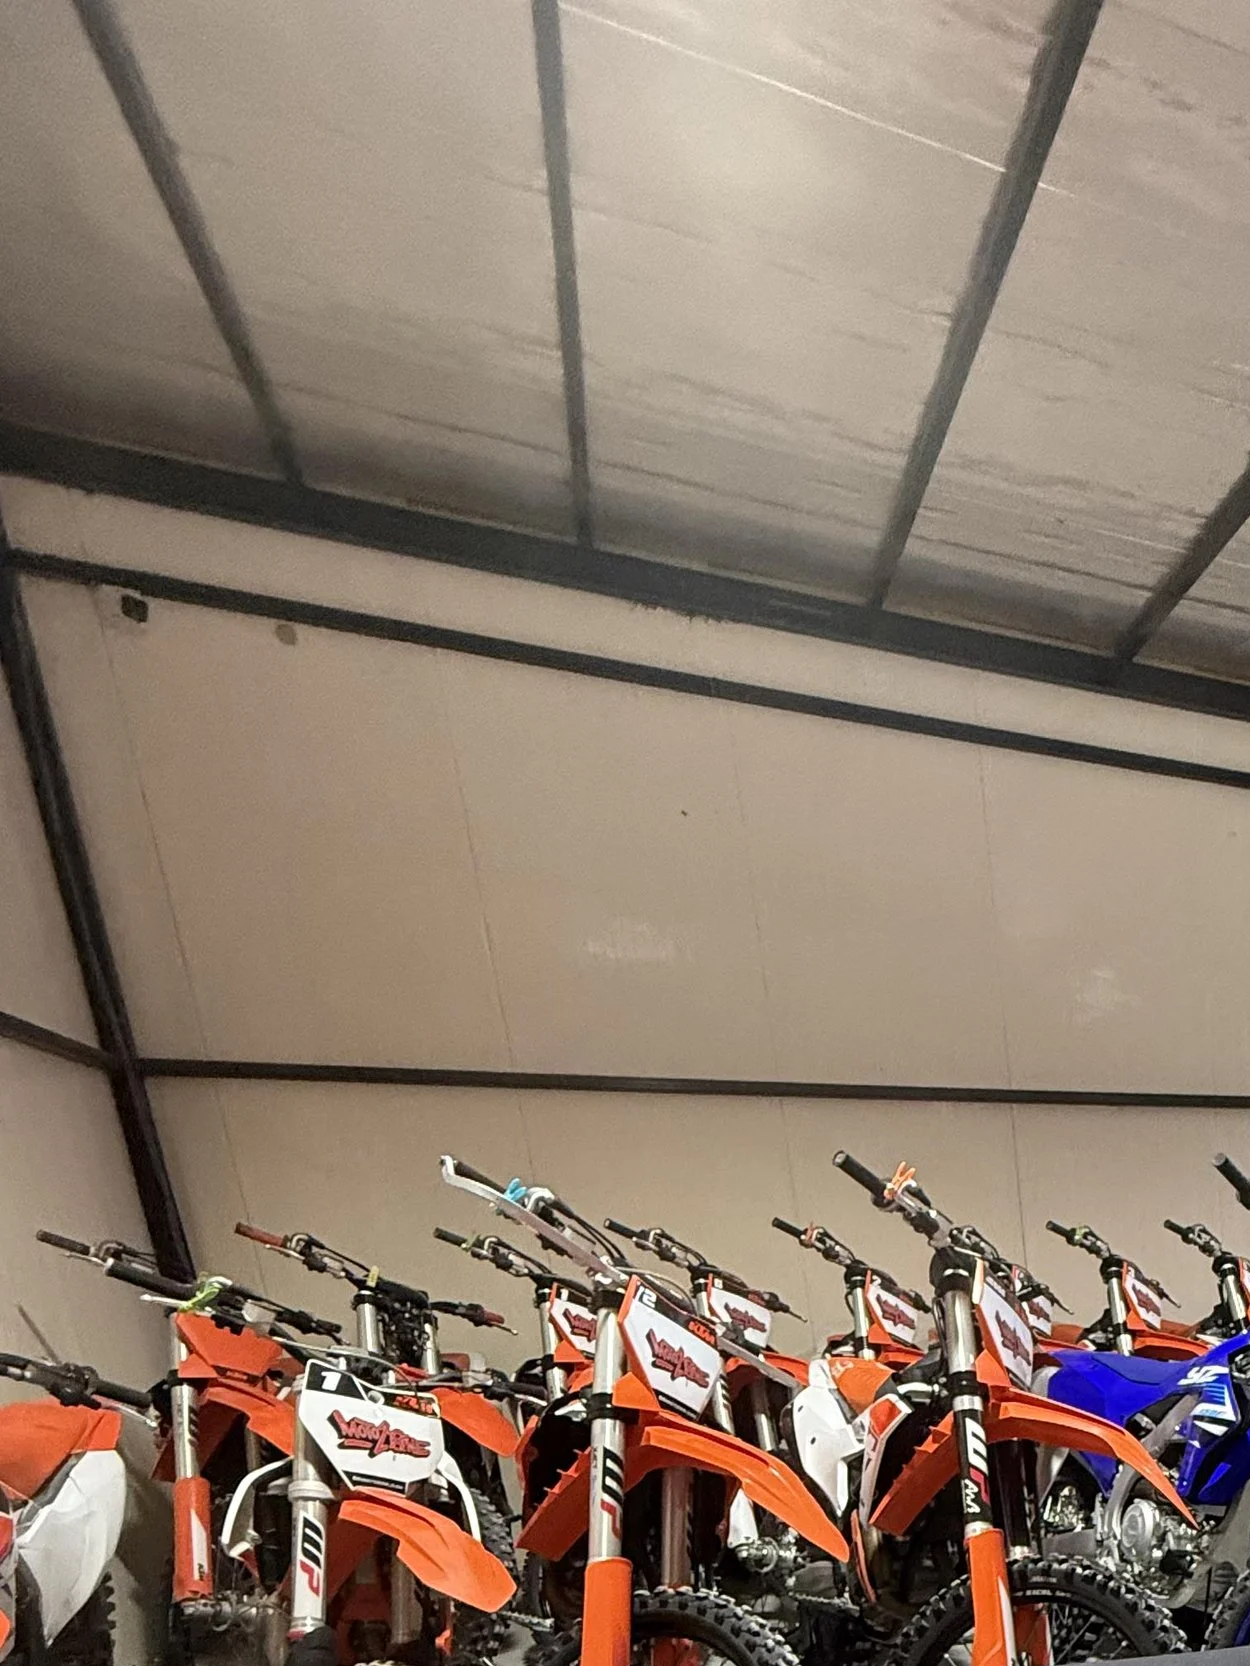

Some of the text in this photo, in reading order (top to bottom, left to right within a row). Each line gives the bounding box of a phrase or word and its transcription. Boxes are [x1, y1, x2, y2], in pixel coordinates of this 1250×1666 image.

[637, 1284, 658, 1308] 12
[321, 1371, 341, 1391] 1
[301, 1515, 323, 1597] WP
